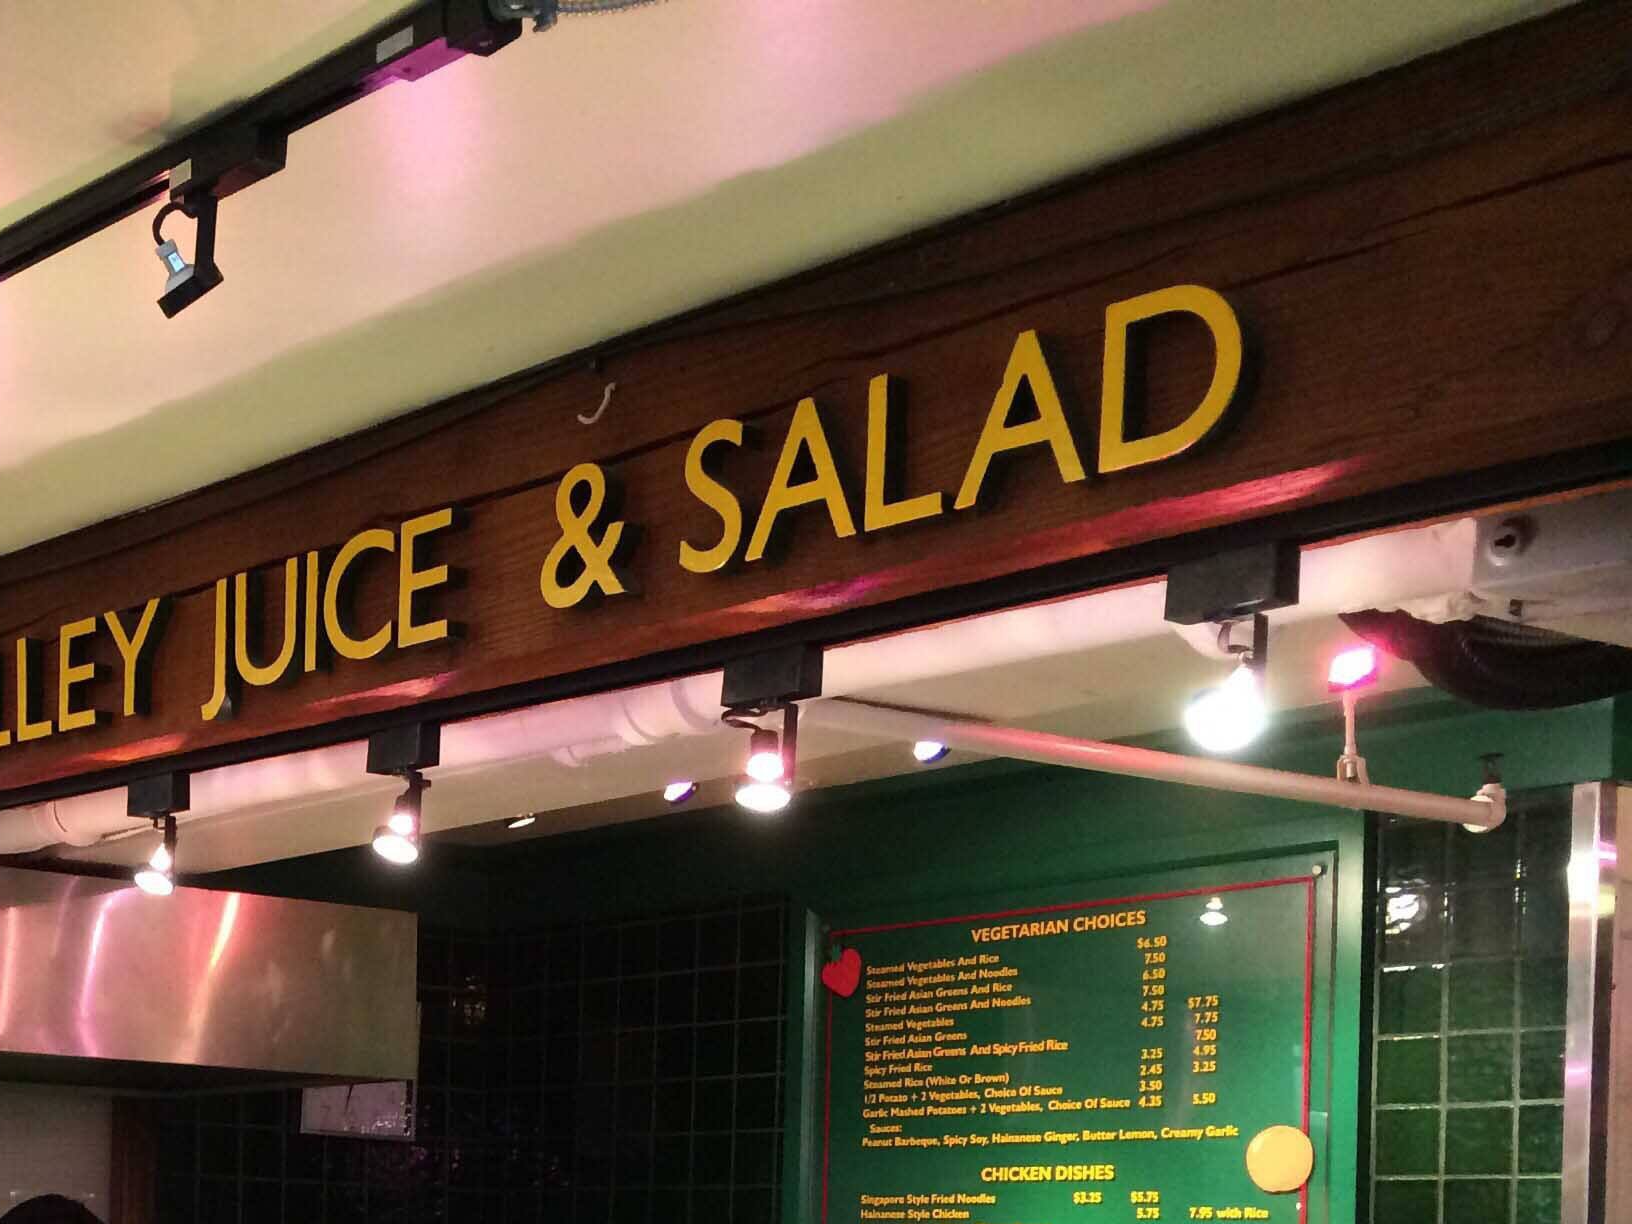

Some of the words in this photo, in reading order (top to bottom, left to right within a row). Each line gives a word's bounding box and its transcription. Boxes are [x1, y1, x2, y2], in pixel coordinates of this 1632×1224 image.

[199, 507, 455, 721] JUICE
[540, 461, 625, 608] &
[678, 282, 1244, 573] SALAD
[971, 919, 1068, 943] VEGETARIAN
[1073, 910, 1147, 932] CHOICES
[866, 963, 904, 975] Steamed
[907, 959, 955, 974] Vegetables
[957, 955, 976, 967] And
[979, 953, 999, 964] Rice
[1137, 935, 1167, 949] $6.50
[866, 977, 904, 989] Steamed
[907, 973, 955, 987] Vegetables
[957, 970, 976, 981] And
[979, 966, 1018, 978] Noodles
[866, 992, 881, 1003] Stir
[884, 991, 907, 1001] Fried
[909, 989, 933, 1000] Asian
[935, 987, 968, 998] Greens
[970, 983, 990, 995] And
[992, 983, 1013, 993] Rice
[1142, 967, 1166, 980] 6.50
[865, 1007, 881, 1018] Stir
[884, 1005, 907, 1016] Fried
[908, 1004, 933, 1015] Asian
[935, 1002, 967, 1012] Greens
[970, 998, 990, 1009] And
[992, 995, 1031, 1007] Noodles
[1142, 984, 1165, 997] 7.50
[865, 1020, 903, 1032] Steamed
[905, 1017, 954, 1031] Vegetables
[1140, 1000, 1164, 1012] 4.75
[1188, 995, 1218, 1009] $7.75
[865, 1037, 880, 1046] Stir
[882, 1034, 905, 1045] Fried
[907, 1033, 932, 1043] Asian
[934, 1032, 967, 1042] Greens
[1140, 1016, 1164, 1027] 4.75
[864, 1065, 885, 1077] Spicy
[888, 1063, 911, 1074] Fried
[913, 1062, 932, 1072] Rice
[1141, 1048, 1163, 1060] 3.25
[1193, 1044, 1217, 1056] 4.95
[865, 1051, 881, 1062] Stir
[882, 1049, 905, 1060] Fried
[906, 1048, 932, 1059] Asian
[933, 1046, 966, 1057] Greens
[970, 1044, 991, 1055] And
[992, 1043, 1018, 1056] Spicy
[1018, 1040, 1045, 1052] Fried
[1046, 1039, 1069, 1050] Rice
[864, 1078, 902, 1089] Steamed
[904, 1077, 923, 1087] Rice
[925, 1076, 956, 1087] (White
[958, 1074, 971, 1084] Or
[974, 1072, 1009, 1084] Brown)
[1140, 1063, 1163, 1076] 2.45
[1193, 1061, 1216, 1073] 3.25
[862, 1108, 888, 1119] Garlic
[890, 1106, 924, 1117] Mashed
[926, 1105, 966, 1116] Potatoes
[980, 1103, 987, 1113] 2
[988, 1101, 1043, 1115] Vegetables,
[1047, 1100, 1082, 1110] Choice
[1084, 1098, 1098, 1109] Of
[1099, 1098, 1131, 1108] Sauce
[1193, 1092, 1216, 1105] 5.50
[878, 1093, 908, 1103] Potato
[920, 1092, 927, 1101] 2
[928, 1089, 980, 1102] Vegetables,
[984, 1087, 1016, 1099] Choice
[1019, 1085, 1032, 1096] Of
[1033, 1085, 1063, 1095] Sauce
[1139, 1080, 1162, 1092] 3.50
[862, 1137, 892, 1147] Peanut
[943, 1134, 968, 1147] Spicy
[991, 1133, 1041, 1144] Hainanese
[1082, 1130, 1116, 1141] Butter
[1161, 1127, 1204, 1141] Creamy
[1205, 1125, 1239, 1137] Garlic
[981, 1166, 1052, 1182] CHICKEN
[1055, 1164, 1115, 1180] DISHES
[860, 1195, 904, 1206] Singapore
[906, 1194, 929, 1205] Style
[931, 1194, 955, 1204] Fried
[957, 1194, 995, 1204] Noodles
[1130, 1191, 1159, 1204] $5.75
[860, 1209, 905, 1219] Hainanese
[907, 1209, 930, 1221] Style
[932, 1209, 969, 1219] Chicken
[1136, 1207, 1160, 1219] 5.75
[1216, 1207, 1242, 1219] with
[1244, 1207, 1269, 1219] Rice
